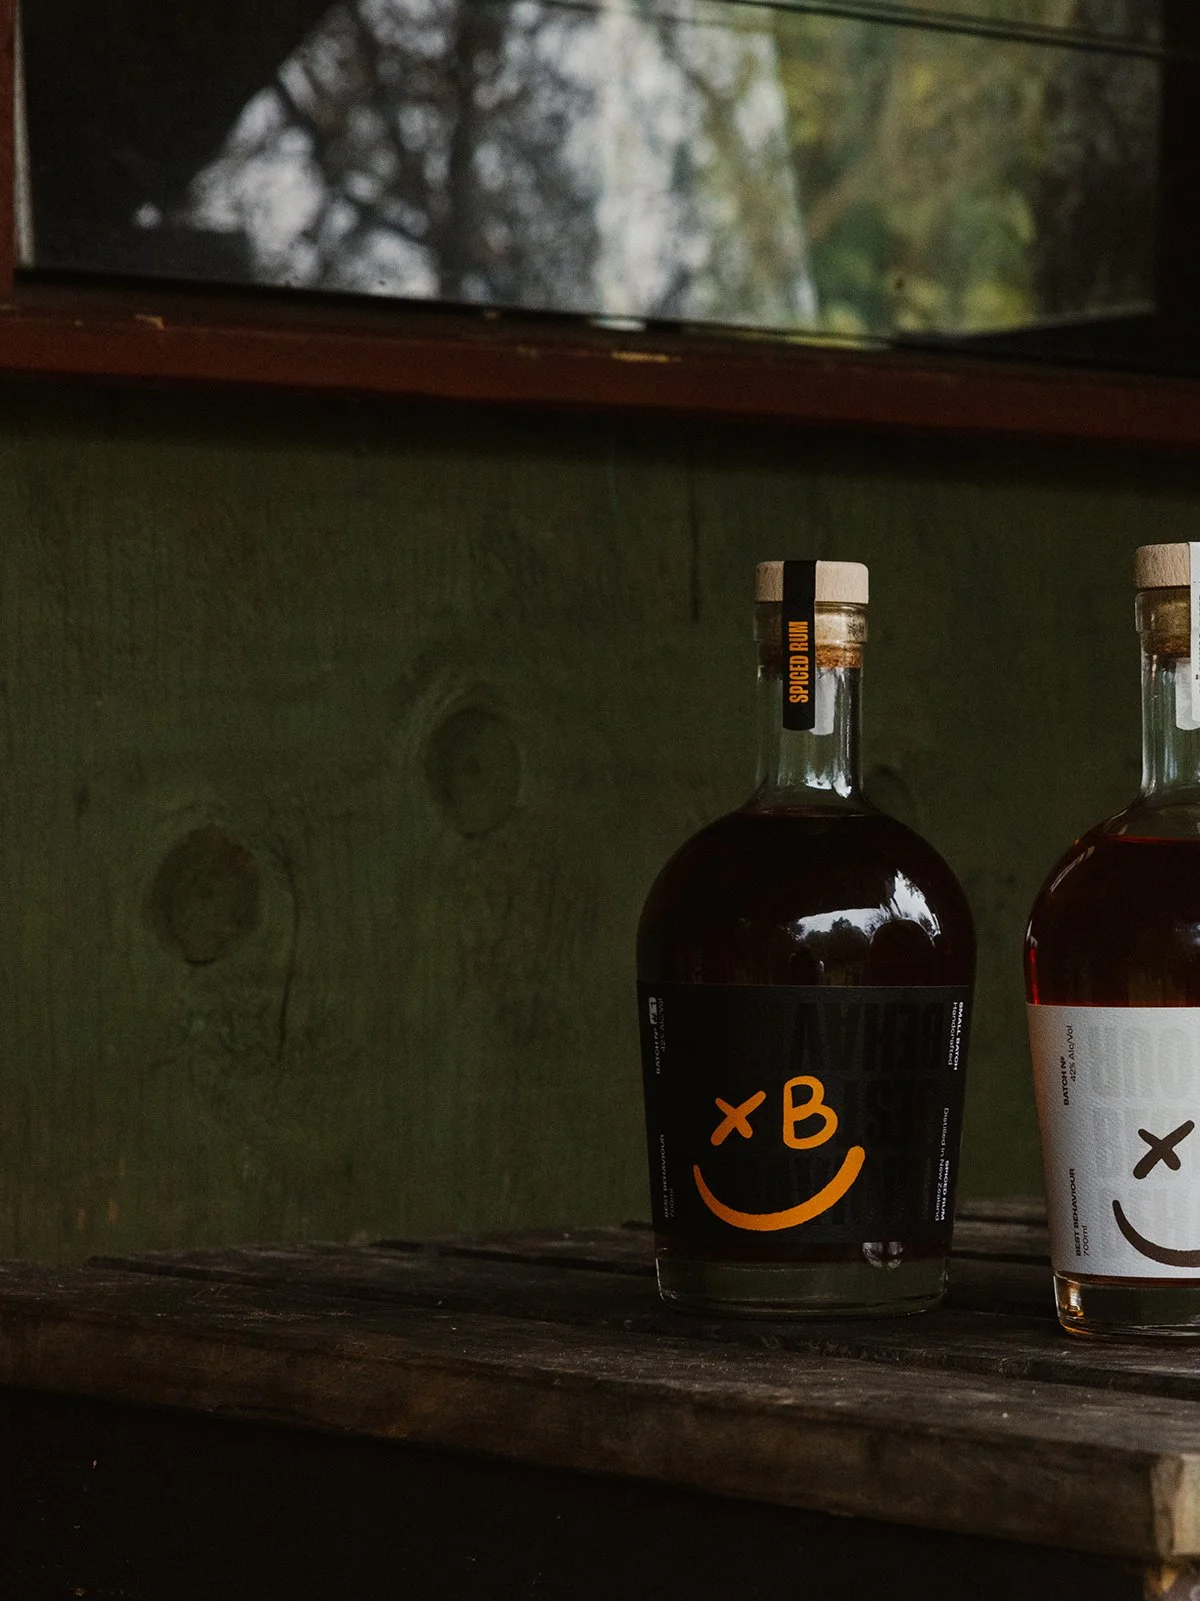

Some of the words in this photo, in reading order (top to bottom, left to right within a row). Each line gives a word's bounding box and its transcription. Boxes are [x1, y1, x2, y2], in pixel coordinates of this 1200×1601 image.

[788, 620, 809, 653] RUM
[788, 656, 809, 704] SPICED
[947, 1001, 959, 1066] Handcrafted
[955, 1001, 964, 1036] SMALL
[953, 1037, 962, 1071] BATCH
[1066, 1025, 1075, 1060] Alc/Vol
[1061, 1071, 1070, 1106] BATCH
[1068, 1062, 1077, 1082] 42%
[941, 1107, 950, 1146] Distilled
[938, 1159, 946, 1181] New
[941, 1160, 950, 1196] SPICED
[934, 1182, 944, 1221] Zealand
[940, 1197, 948, 1221] RUM
[1069, 1168, 1080, 1229] BEHAVIOUR
[1074, 1231, 1082, 1257] BEST
